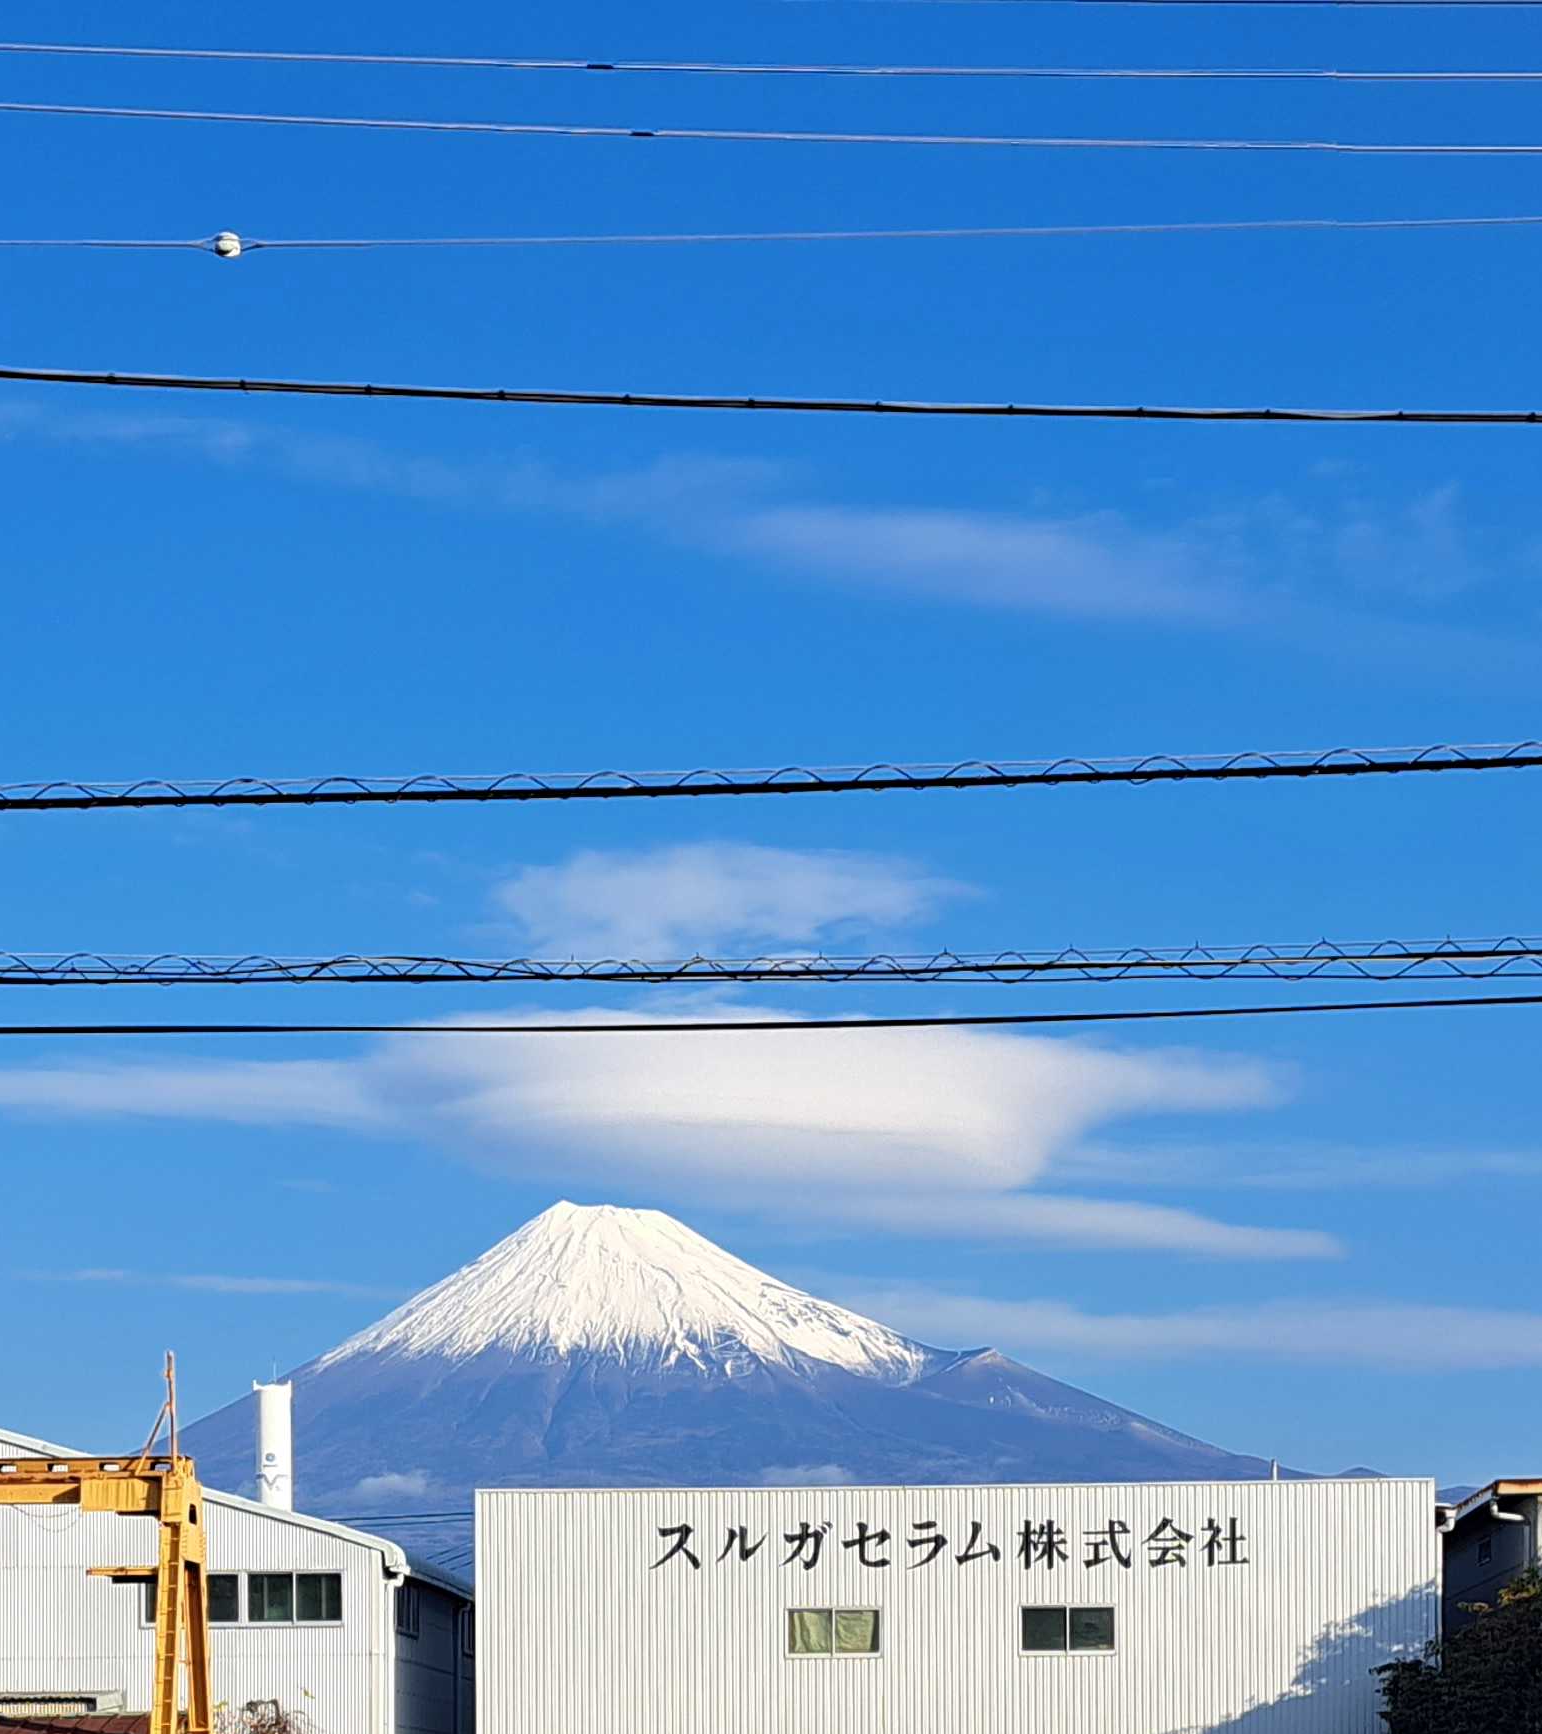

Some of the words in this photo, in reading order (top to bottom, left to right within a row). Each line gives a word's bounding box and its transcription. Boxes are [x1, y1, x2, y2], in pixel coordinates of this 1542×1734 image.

[649, 1516, 1250, 1570] スルガセラム株式会社
